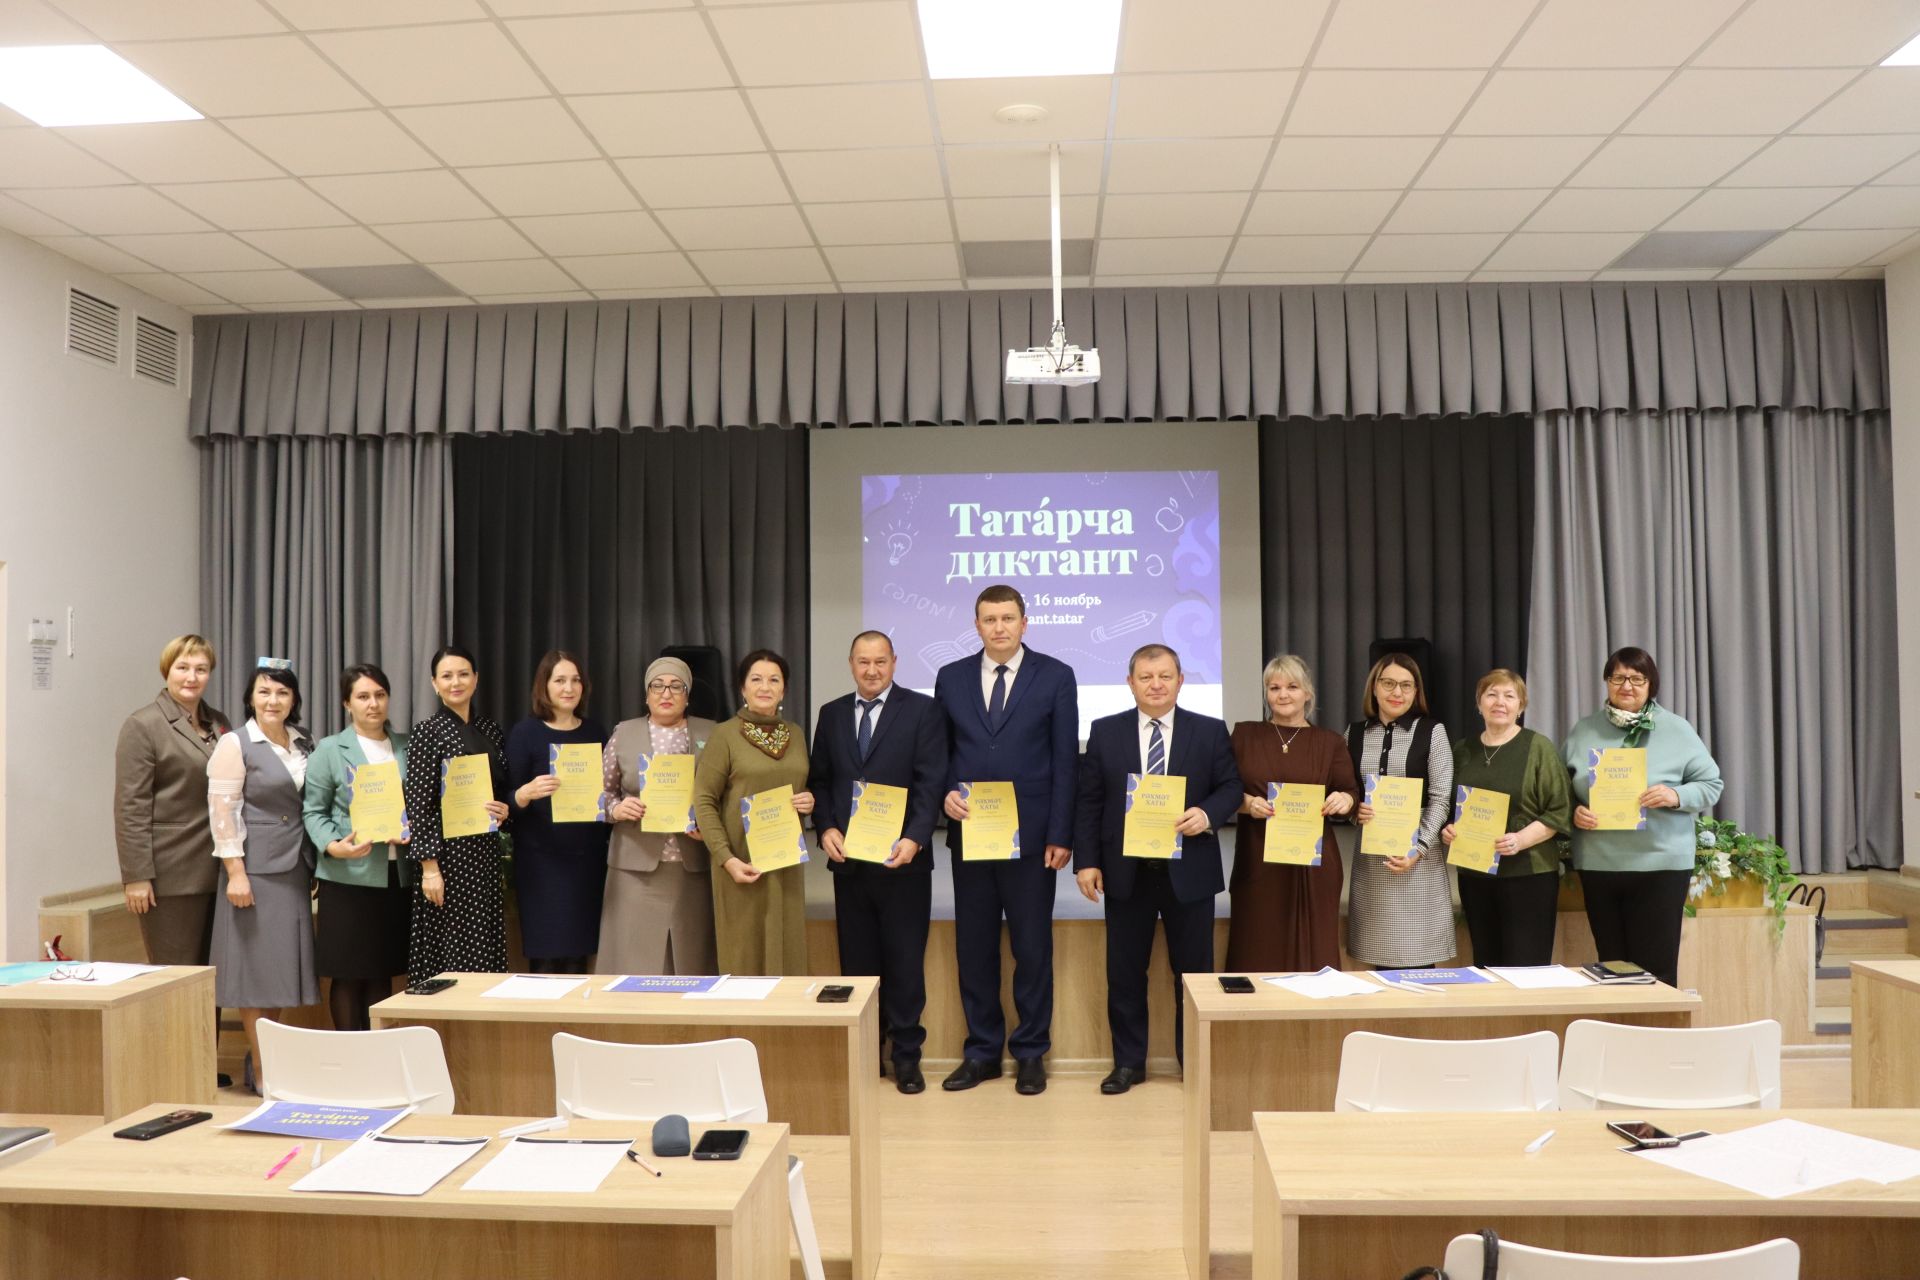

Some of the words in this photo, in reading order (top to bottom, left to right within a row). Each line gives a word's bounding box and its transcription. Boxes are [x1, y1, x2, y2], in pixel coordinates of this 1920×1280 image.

[946, 549, 1138, 584] диктант
[1033, 593, 1050, 606] 16
[1053, 592, 1102, 609] ноябрь
[1026, 613, 1084, 625] ant.tatar
